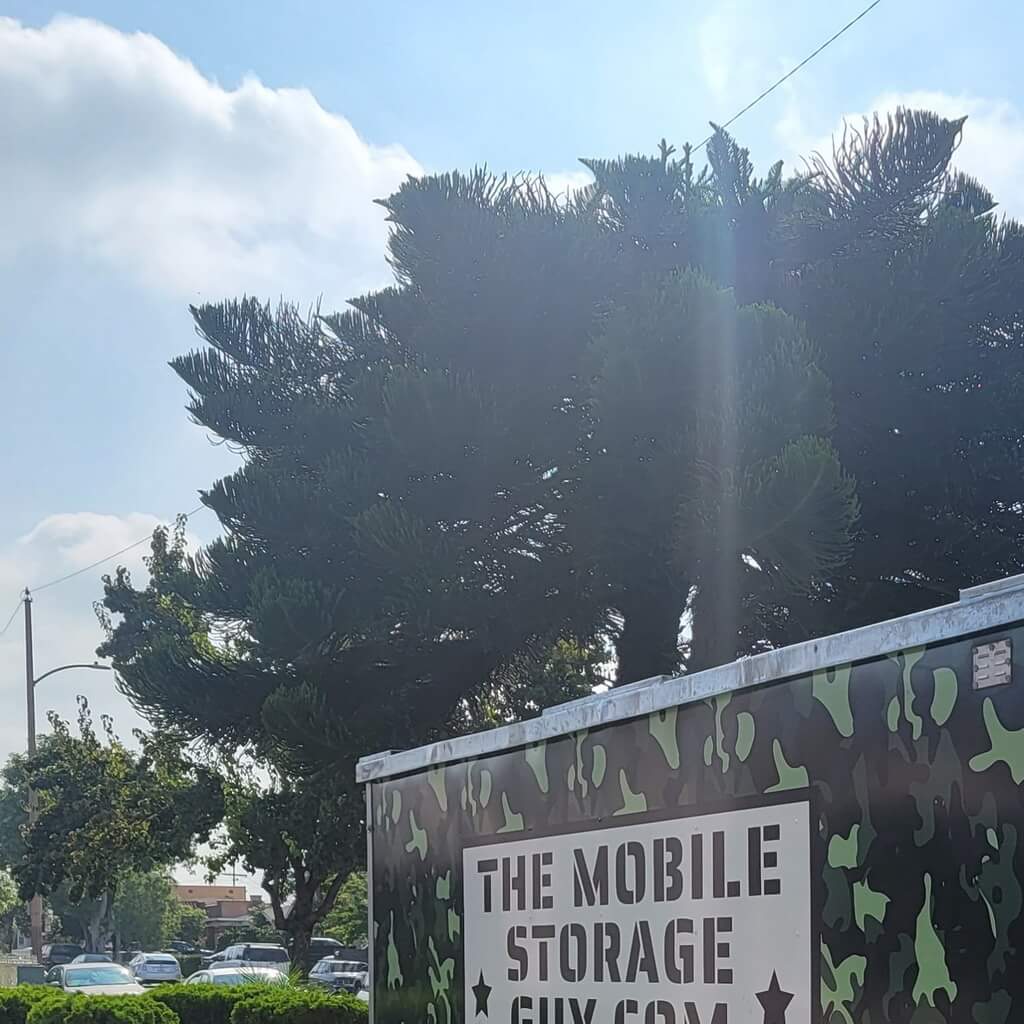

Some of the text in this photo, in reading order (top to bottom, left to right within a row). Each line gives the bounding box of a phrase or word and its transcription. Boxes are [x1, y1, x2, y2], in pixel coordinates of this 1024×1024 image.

[477, 824, 781, 912] THE MOBILE
[507, 917, 733, 984] STORAGE
